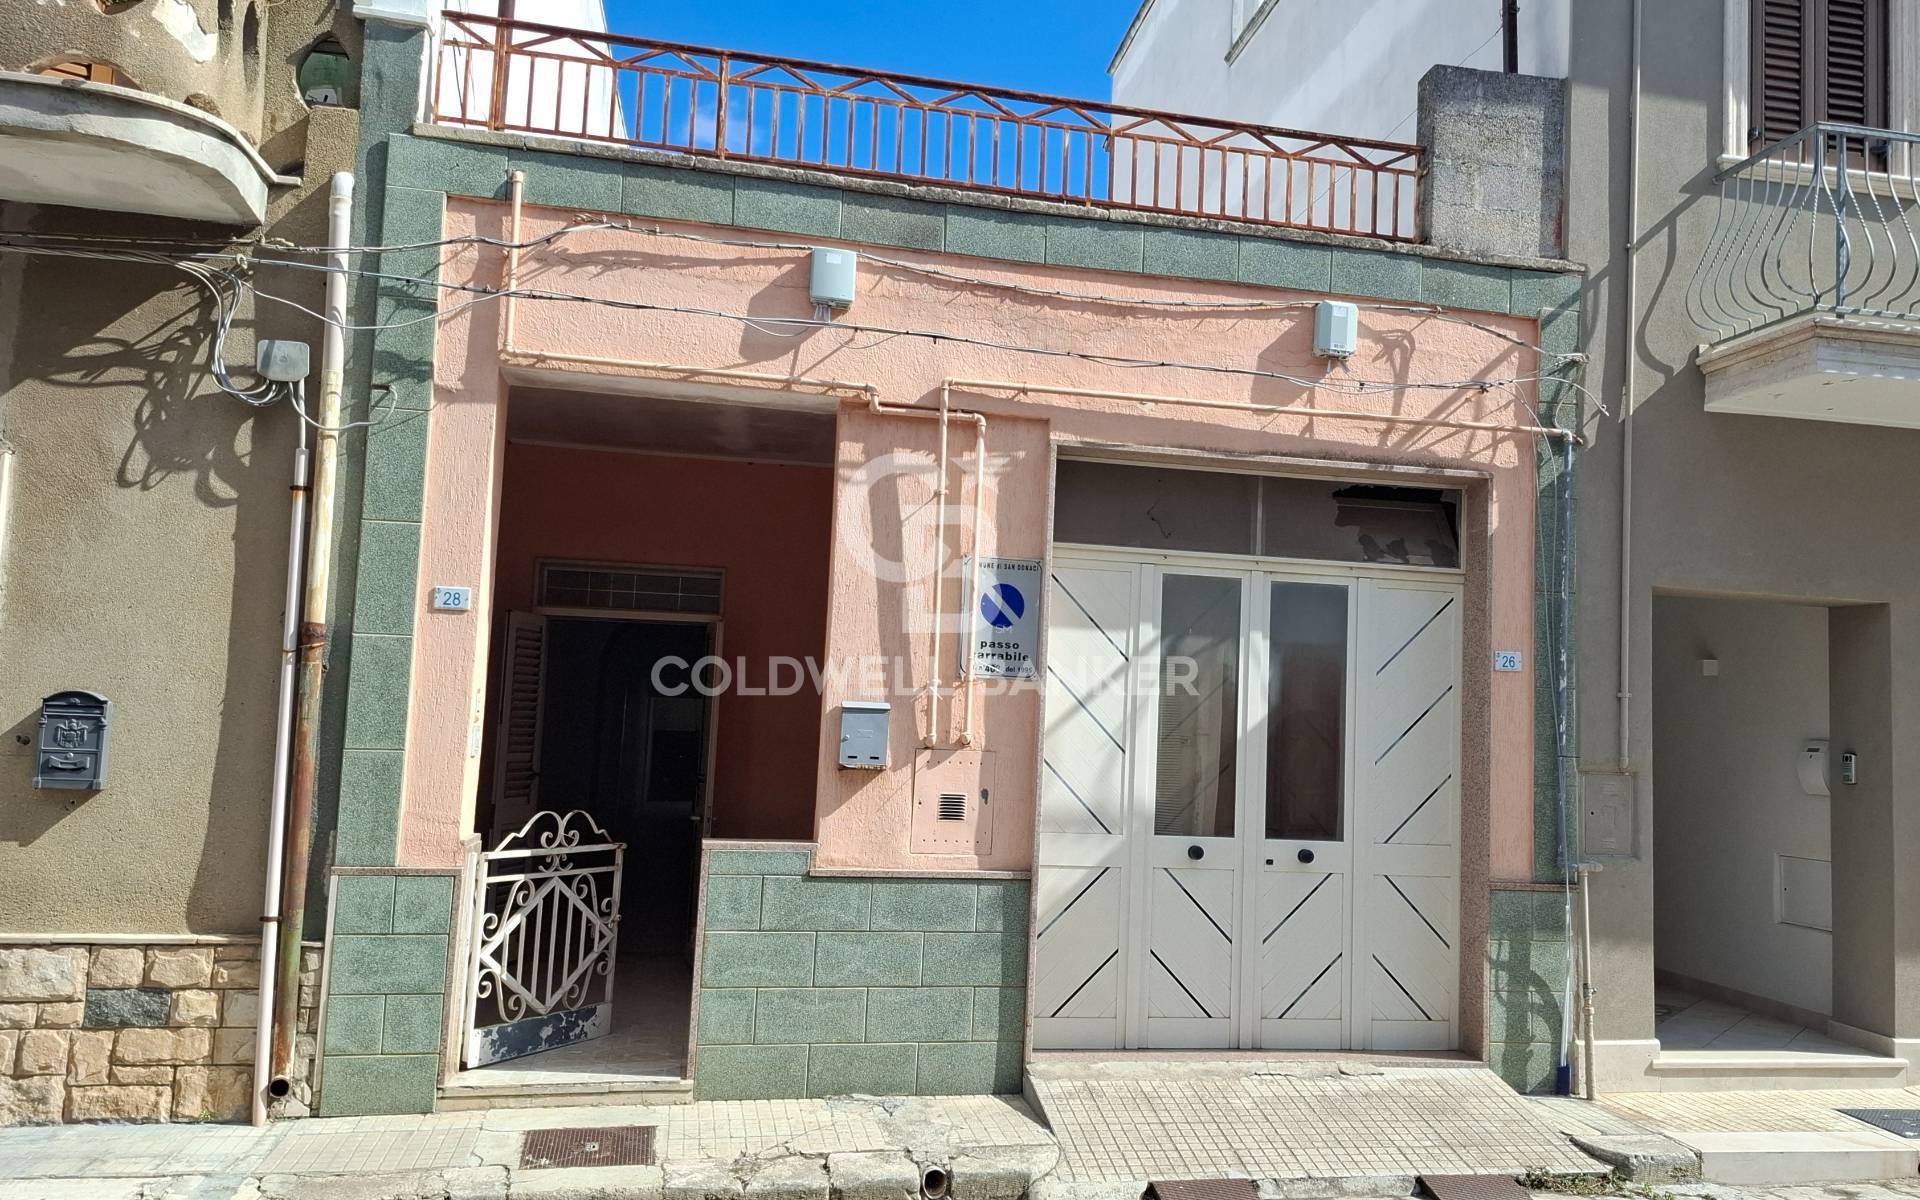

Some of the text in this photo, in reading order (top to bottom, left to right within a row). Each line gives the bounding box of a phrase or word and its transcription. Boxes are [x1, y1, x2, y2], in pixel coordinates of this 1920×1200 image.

[443, 591, 461, 606] 28
[980, 640, 1020, 650] passo
[977, 651, 1029, 662] arrabile
[1502, 655, 1515, 668] 26
